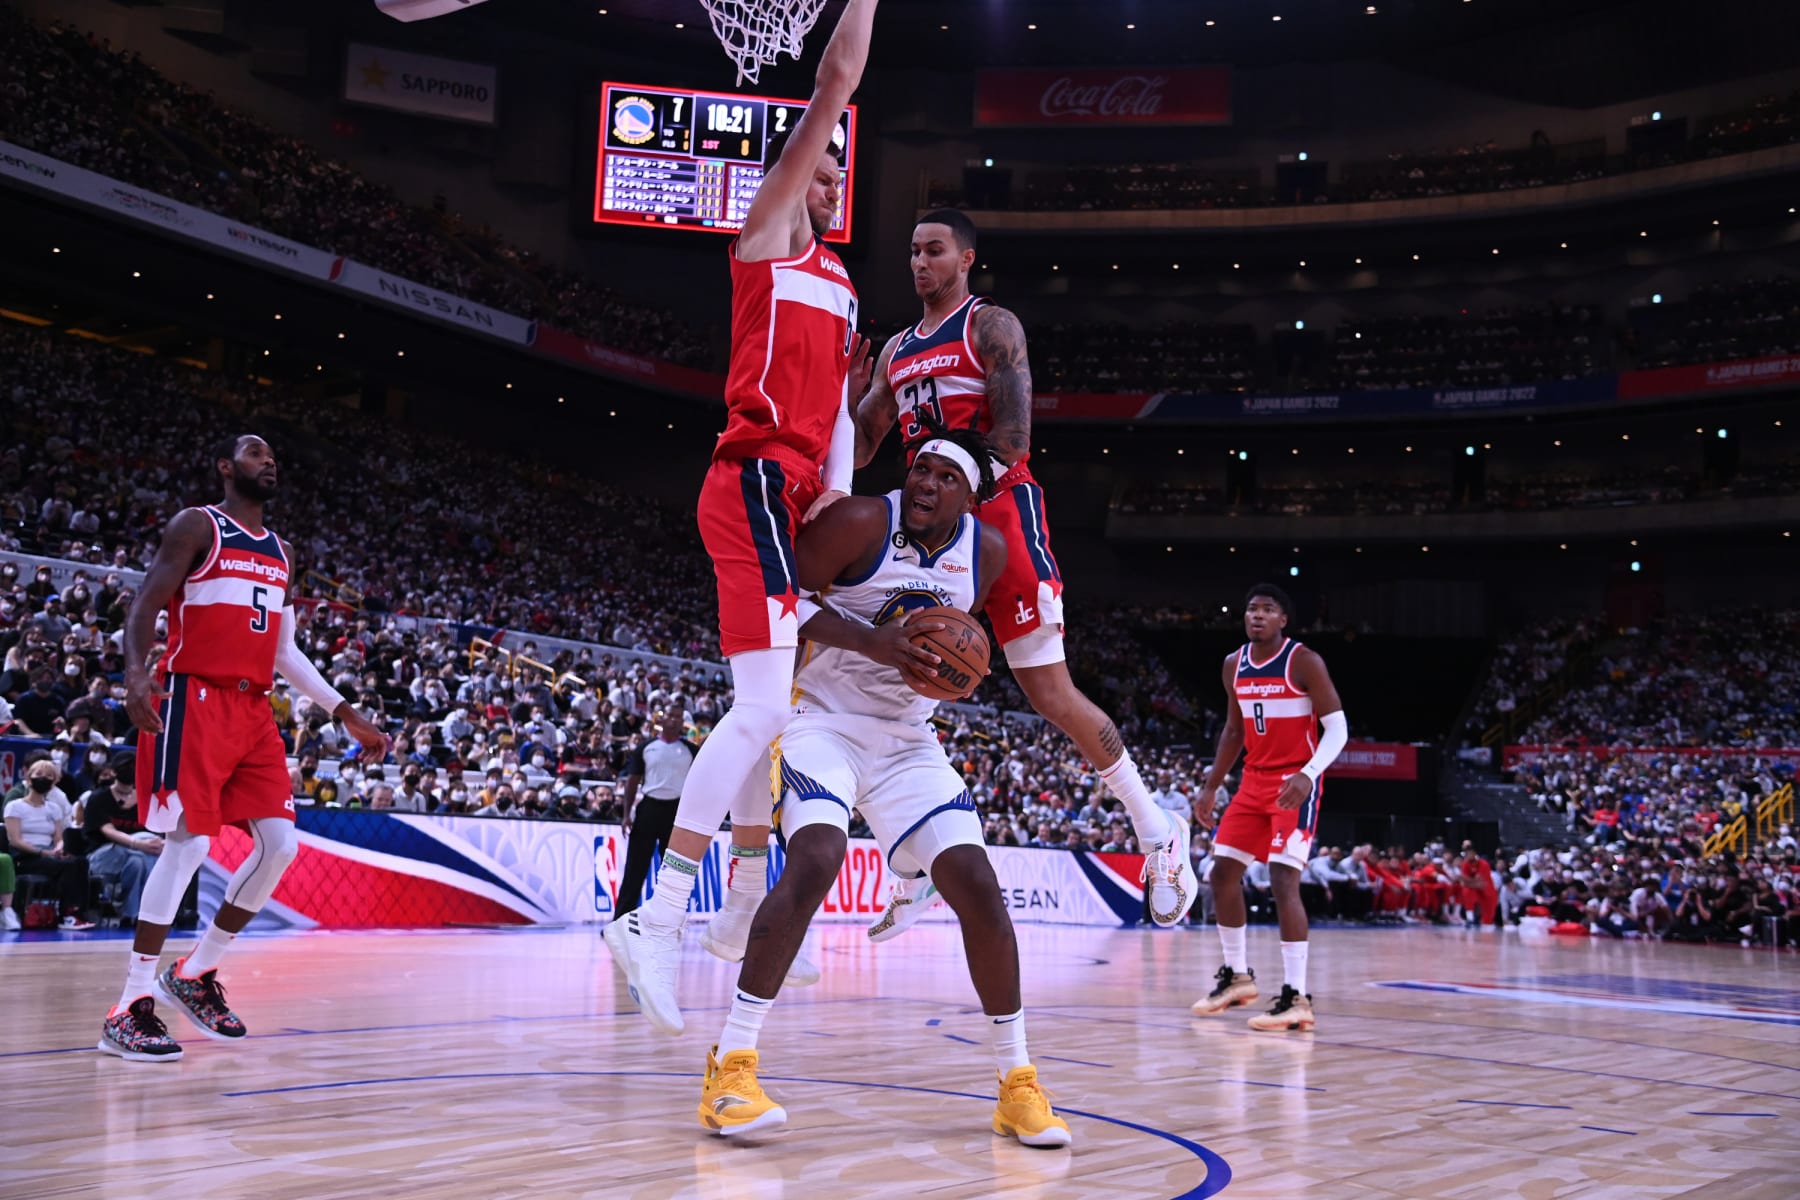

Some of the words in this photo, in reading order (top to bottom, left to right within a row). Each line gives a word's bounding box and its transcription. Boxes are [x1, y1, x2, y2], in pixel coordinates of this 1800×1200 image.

[400, 72, 489, 104] SAPPORO
[1039, 75, 1169, 117] Coca-Cola
[672, 97, 684, 123] 7
[707, 103, 753, 134] 10:21
[775, 107, 788, 132] 2
[378, 276, 494, 328] NISSAN
[890, 354, 960, 385] washington
[904, 377, 944, 437] 33
[218, 517, 226, 527] 6
[895, 534, 905, 547] 6
[219, 557, 288, 583] washington
[941, 562, 969, 574] Rakuten
[885, 581, 928, 598] GOLDEN
[250, 586, 268, 633] 5
[1254, 703, 1266, 735] 8
[1000, 888, 1059, 909] SSAN
